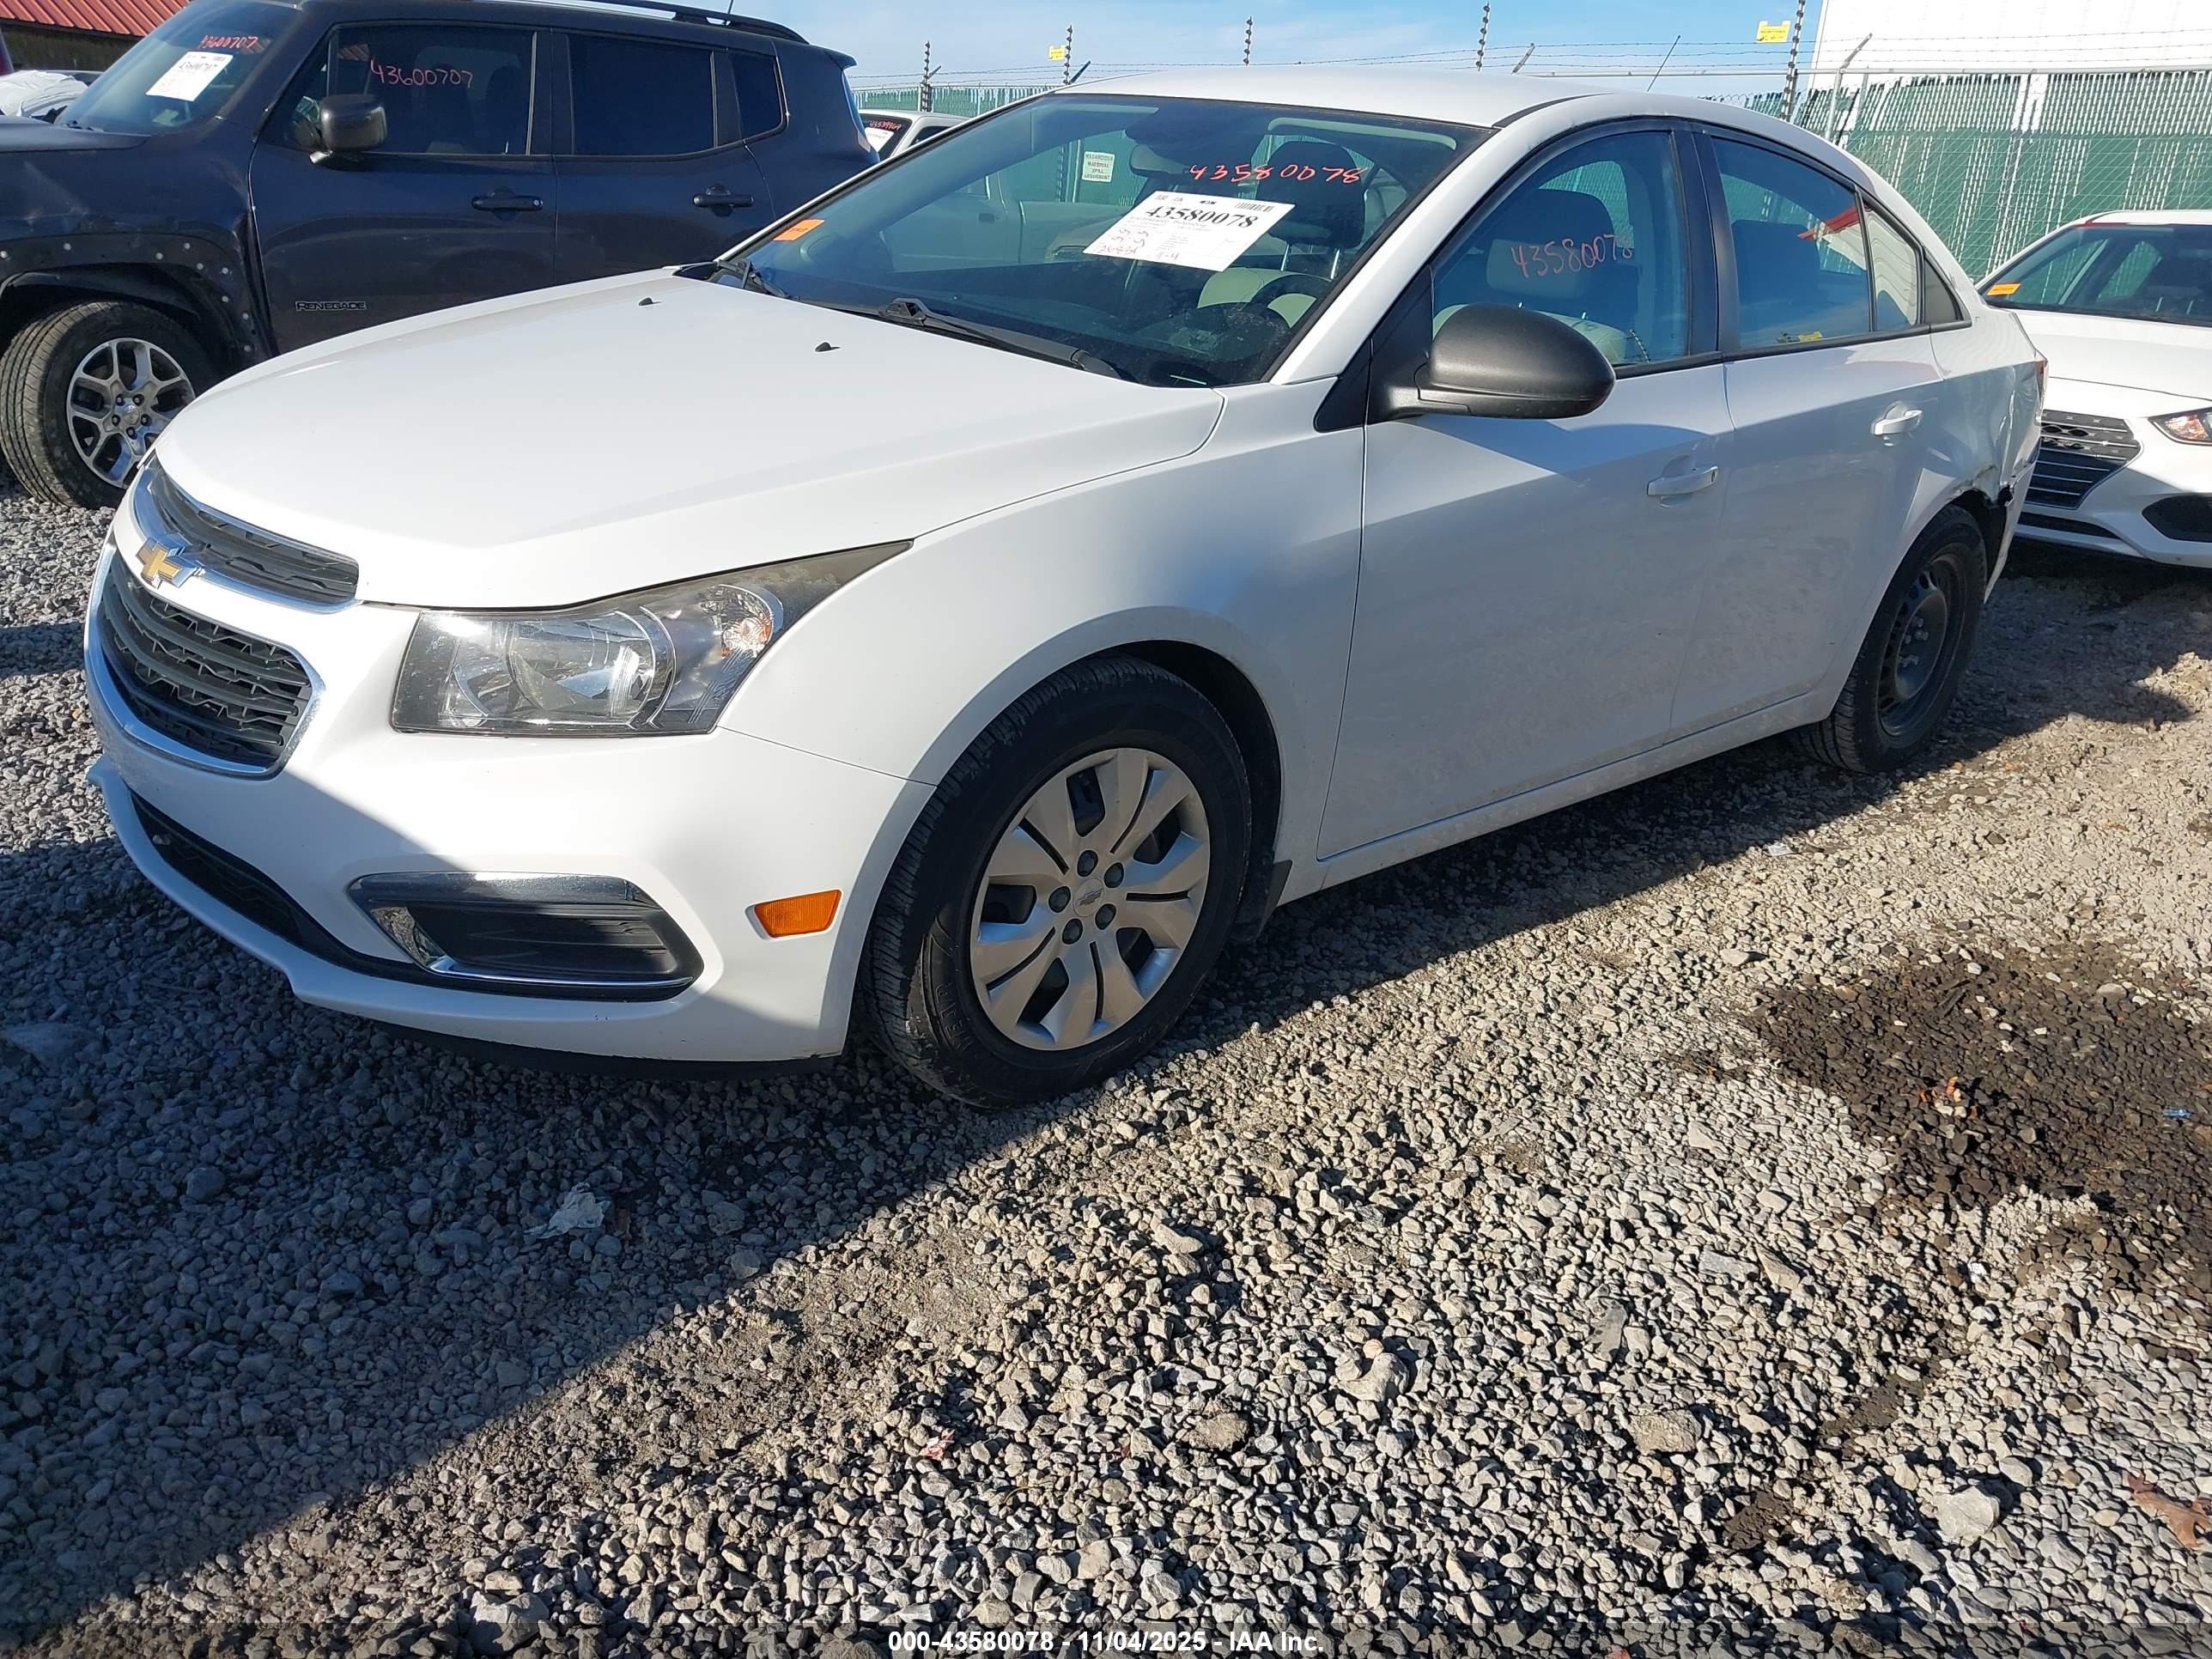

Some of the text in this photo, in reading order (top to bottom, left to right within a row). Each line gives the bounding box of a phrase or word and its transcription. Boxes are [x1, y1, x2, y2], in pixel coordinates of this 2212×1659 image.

[370, 59, 473, 88] 43600707
[1189, 164, 1368, 184] 43580078
[1146, 206, 1260, 228] 43580078
[295, 301, 367, 311] RENEGADE
